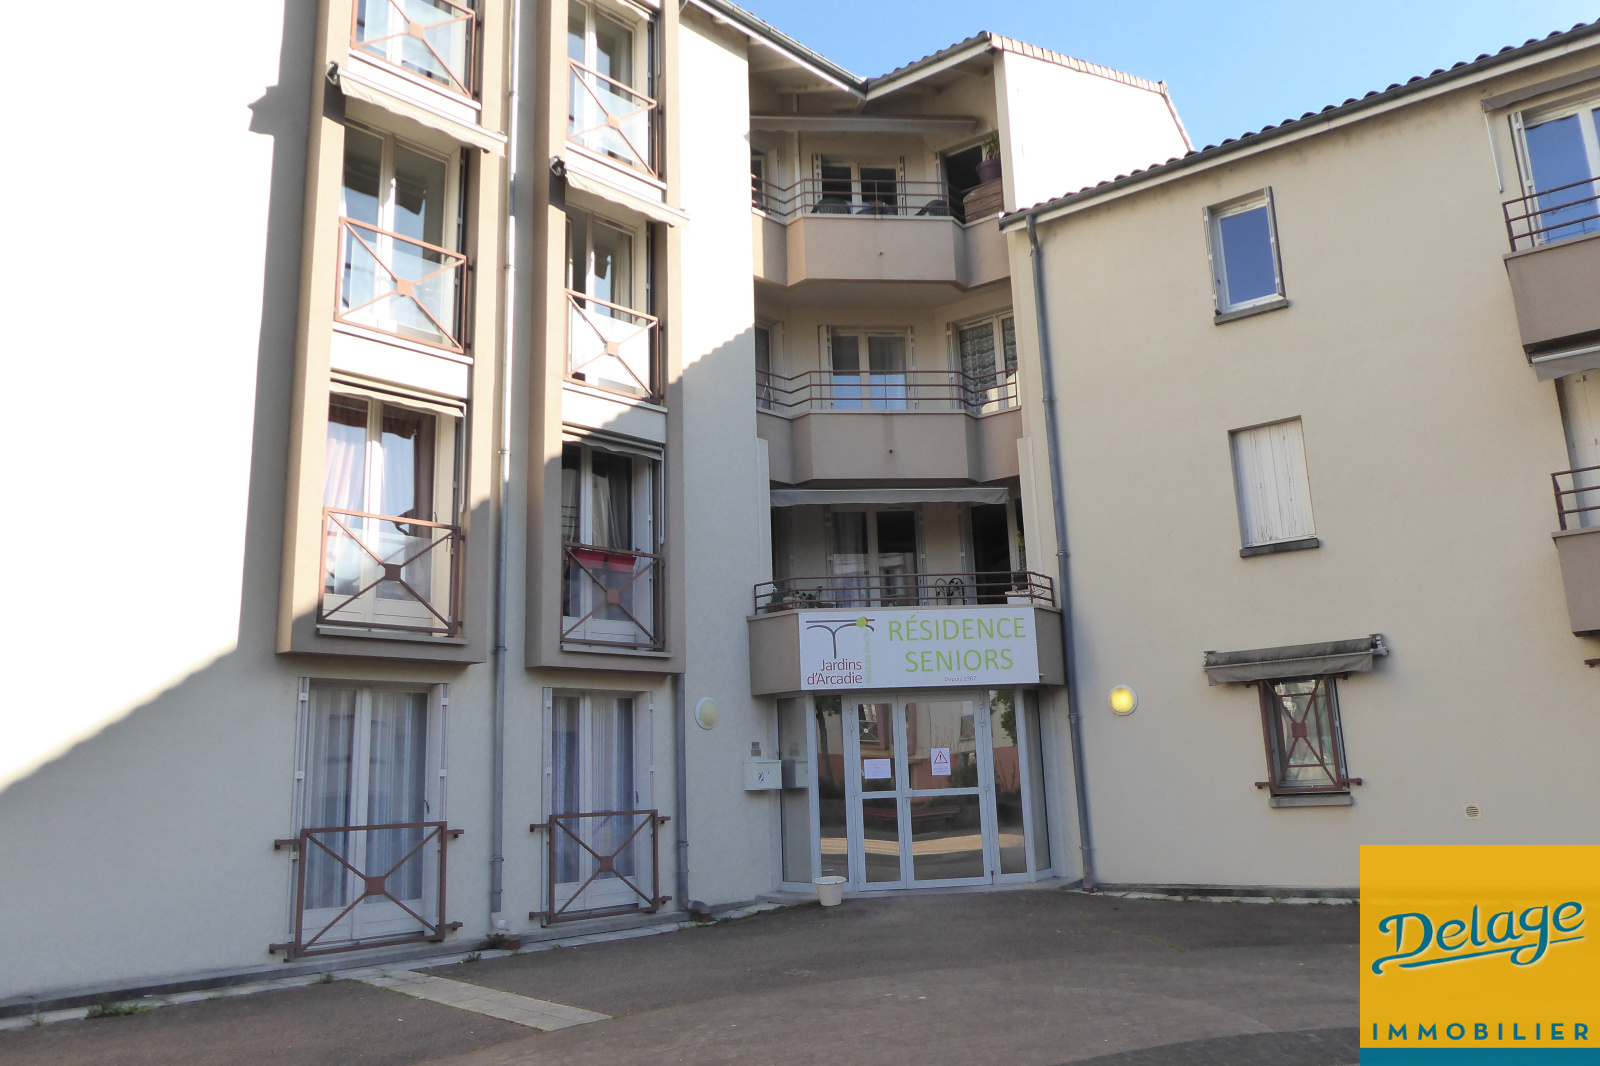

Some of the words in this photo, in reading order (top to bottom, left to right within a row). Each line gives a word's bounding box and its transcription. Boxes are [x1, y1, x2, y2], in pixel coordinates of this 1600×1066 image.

[888, 613, 1027, 642] RÉSIDENCE
[821, 658, 862, 672] Jardins
[905, 648, 1014, 673] SENIORS
[807, 672, 863, 686] d'Arcadie
